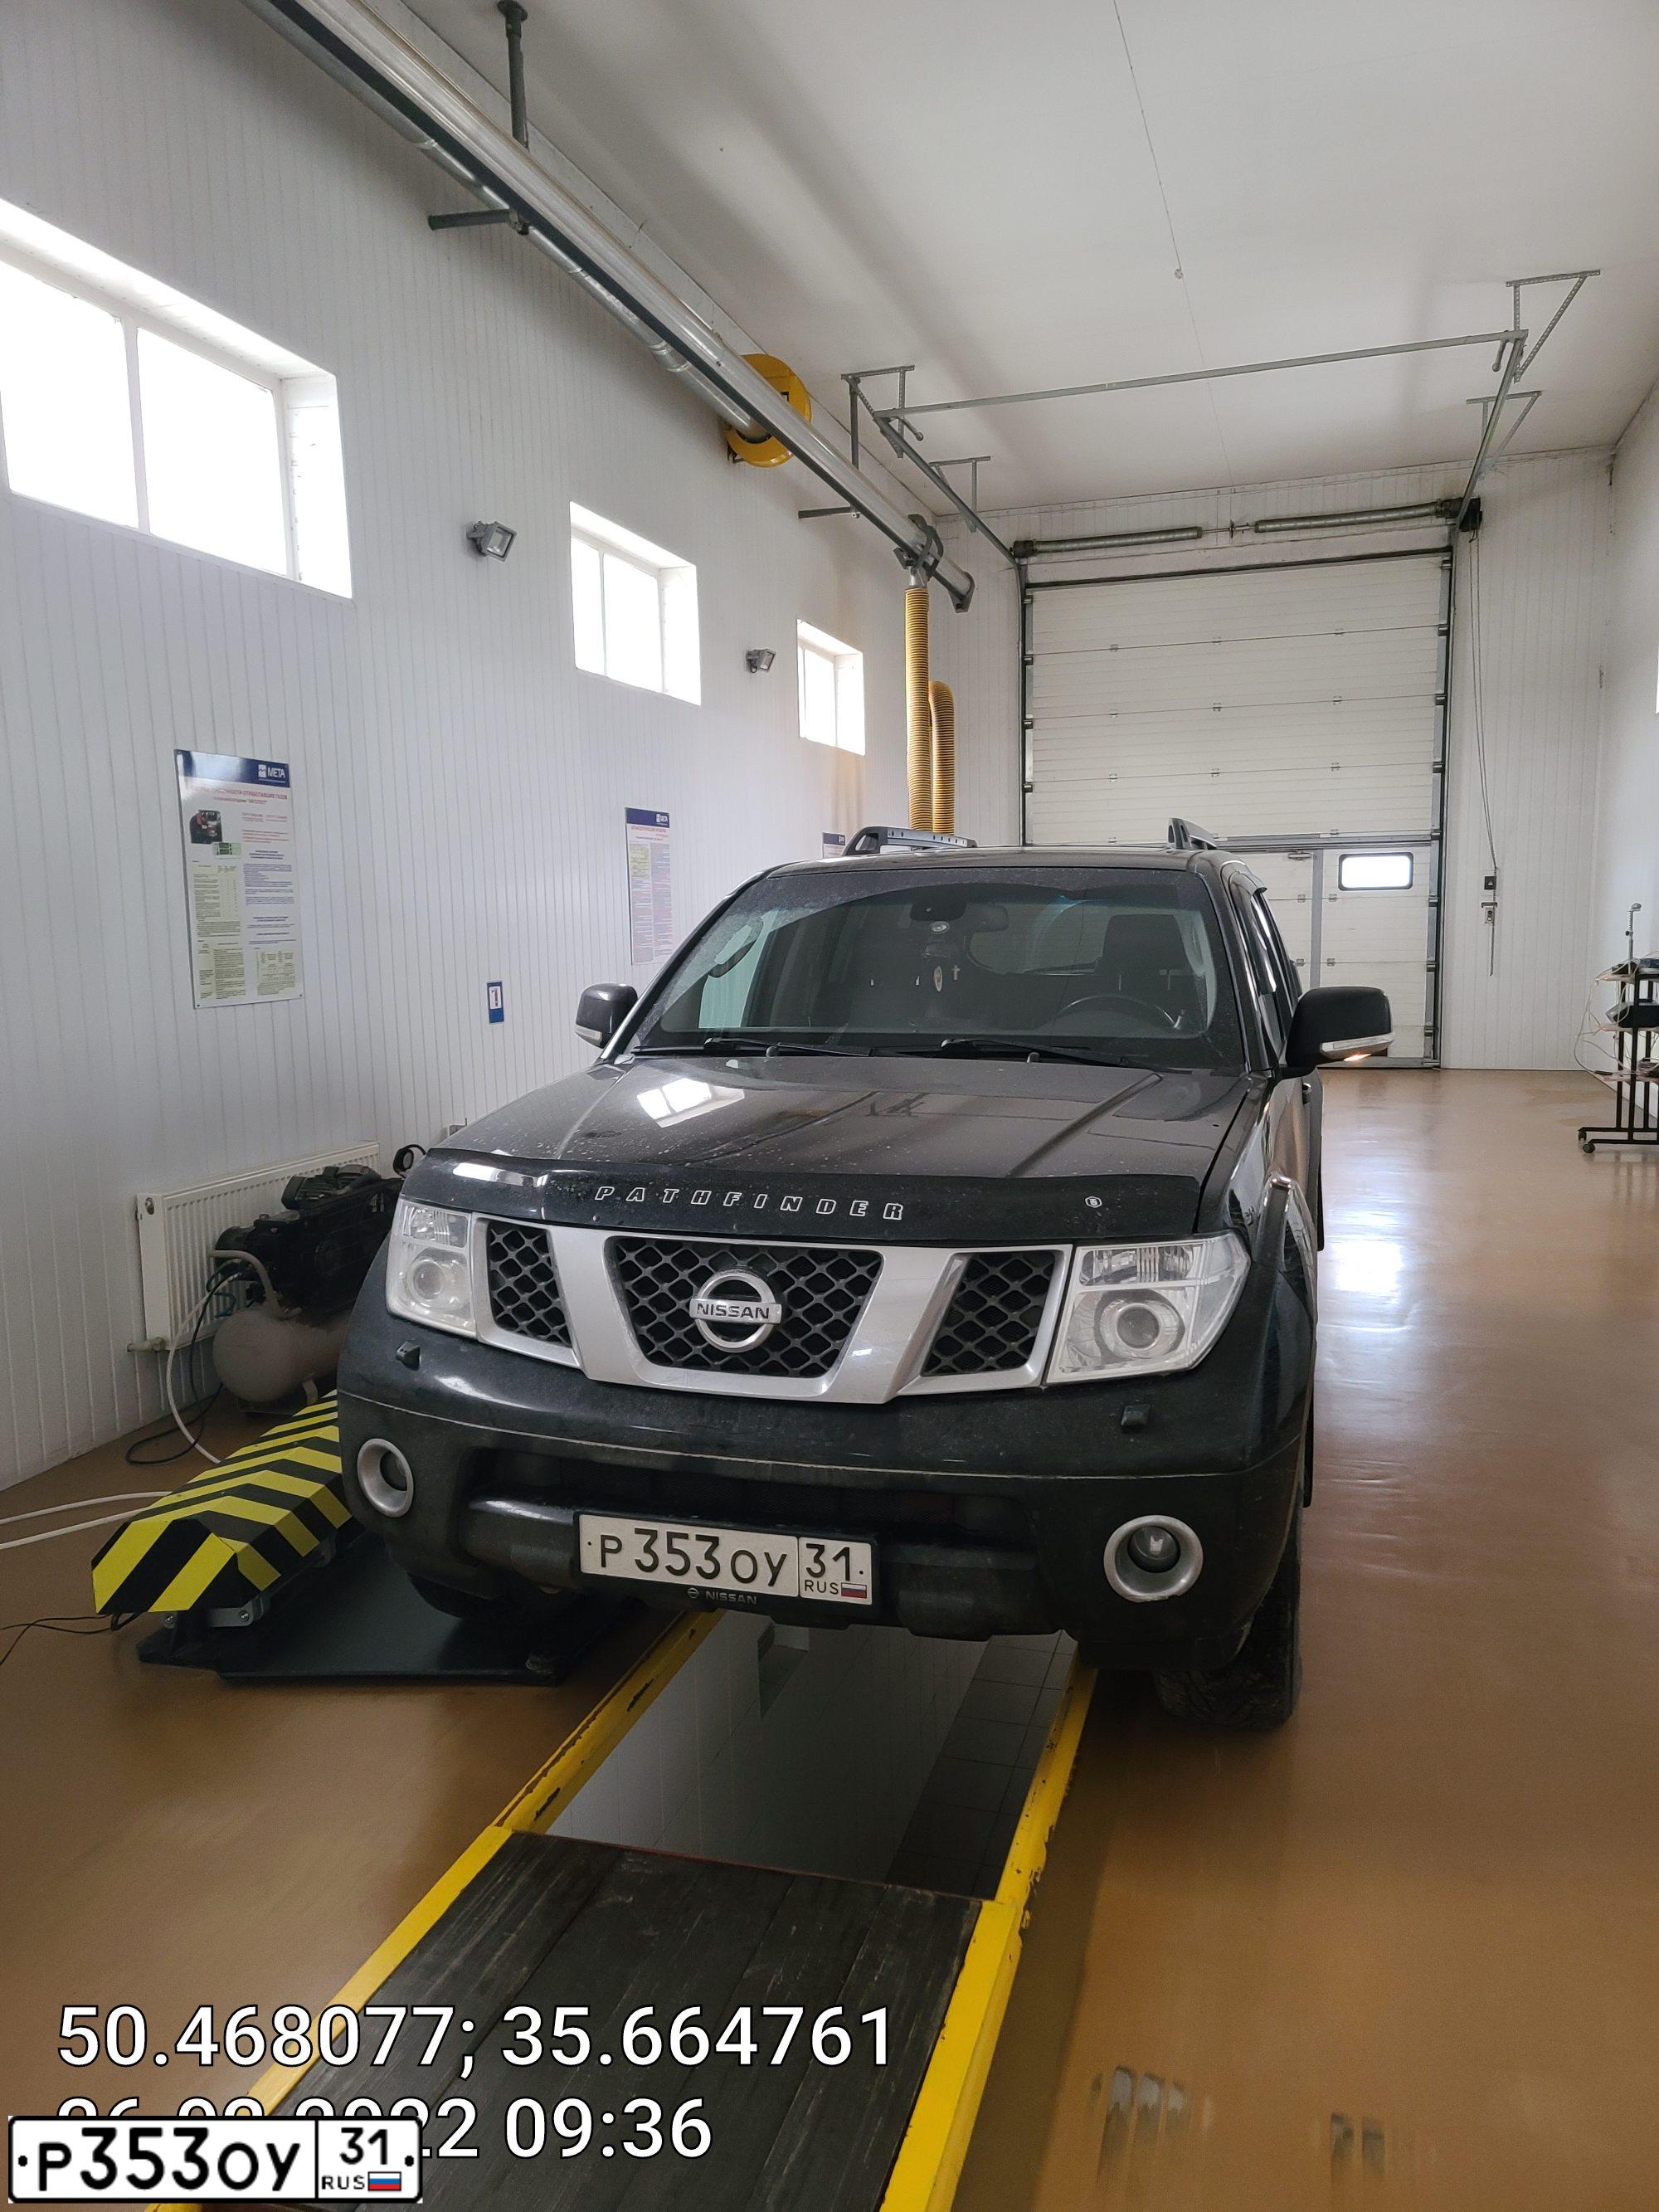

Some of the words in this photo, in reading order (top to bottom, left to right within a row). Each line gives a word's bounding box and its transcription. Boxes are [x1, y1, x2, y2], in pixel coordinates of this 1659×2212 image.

[595, 1186, 904, 1220] PATHFINDER
[696, 1303, 770, 1320] NISSAN
[805, 1543, 851, 1581] 31
[805, 1580, 839, 1595] RUS
[705, 1591, 757, 1605] NISSAN
